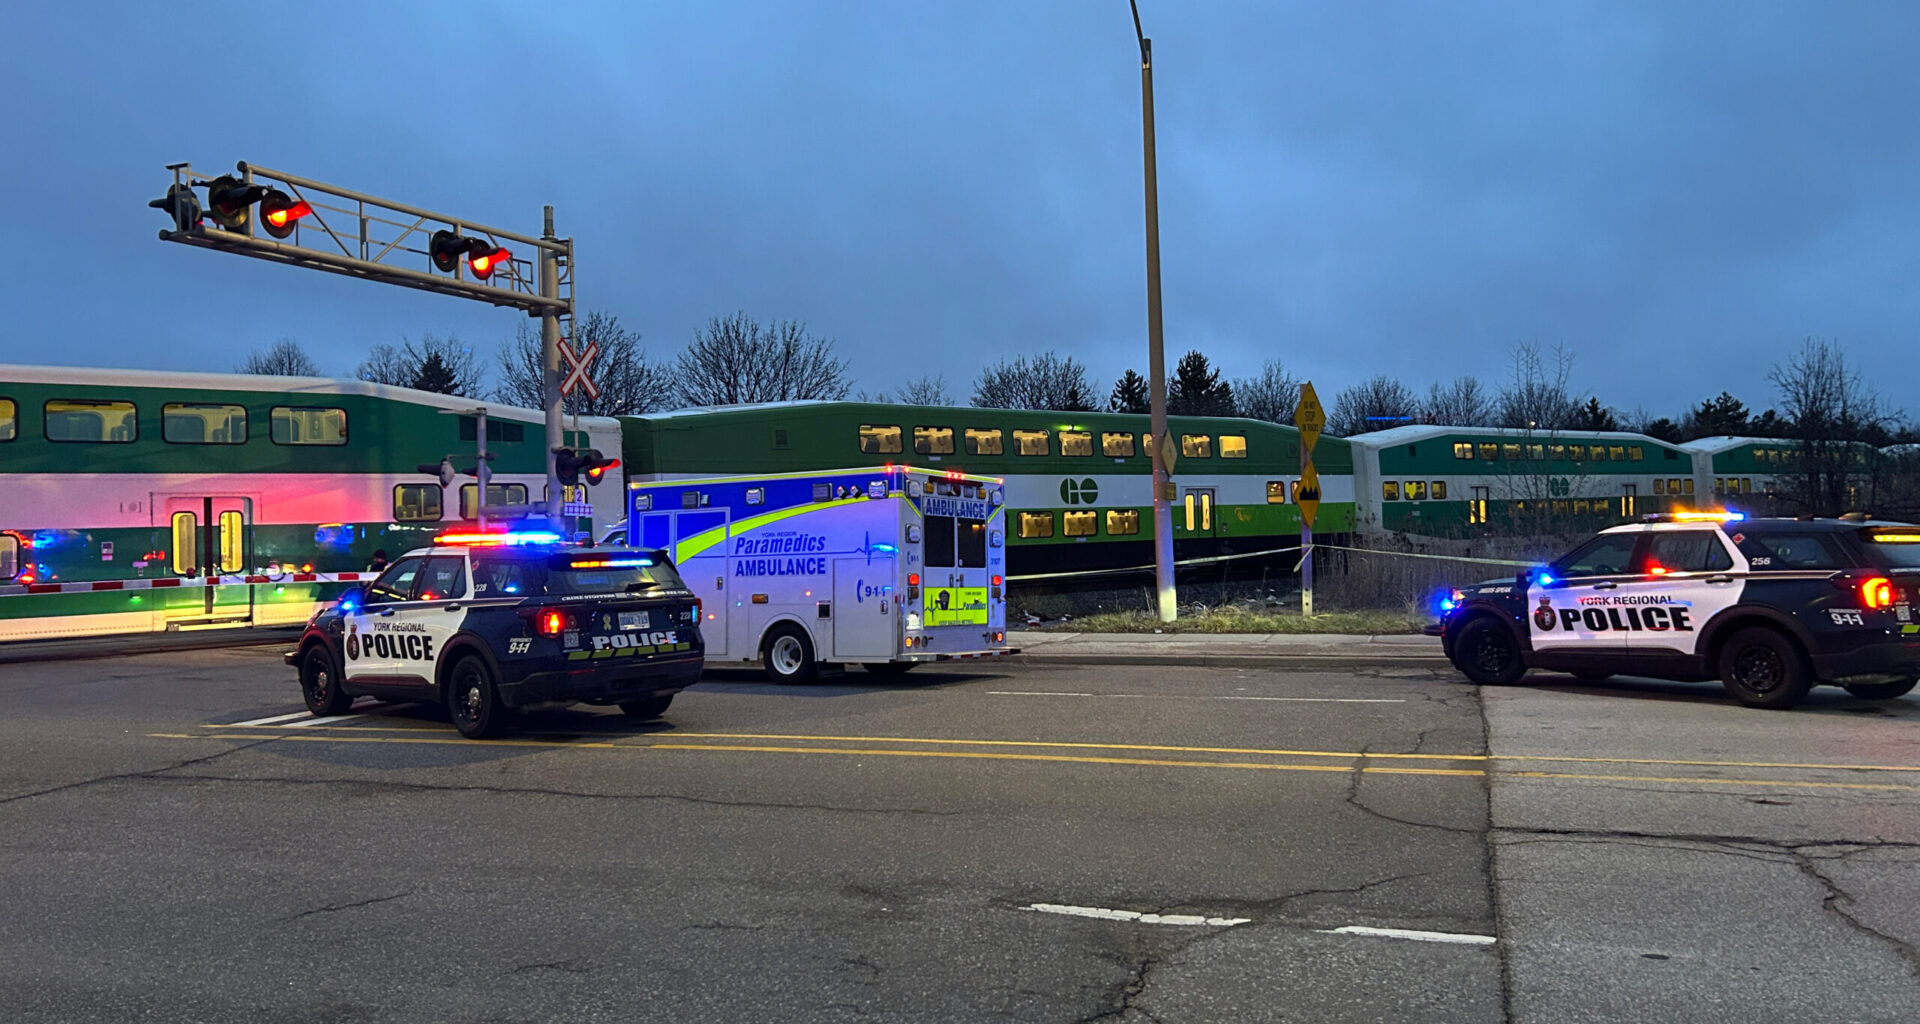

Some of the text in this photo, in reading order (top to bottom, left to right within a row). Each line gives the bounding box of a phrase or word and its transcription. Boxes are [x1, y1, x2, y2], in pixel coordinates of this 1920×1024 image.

[1304, 411, 1316, 422] STOP
[576, 490, 583, 502] 2
[1060, 477, 1098, 505] GO
[925, 498, 984, 518] AMBULANCE
[735, 533, 827, 555] Paramedics
[735, 557, 827, 577] AMBULANCE
[1751, 557, 1771, 566] 256
[864, 585, 887, 598] 9-1-1
[1578, 595, 1677, 606] YORK REGIONAL
[1558, 606, 1694, 632] POLICE
[1830, 613, 1865, 626] 9-1-1
[373, 622, 427, 633] YORK REGIONAL
[361, 633, 435, 661] POLICE
[591, 631, 678, 650] POLICE
[508, 642, 531, 654] 9-1-1
